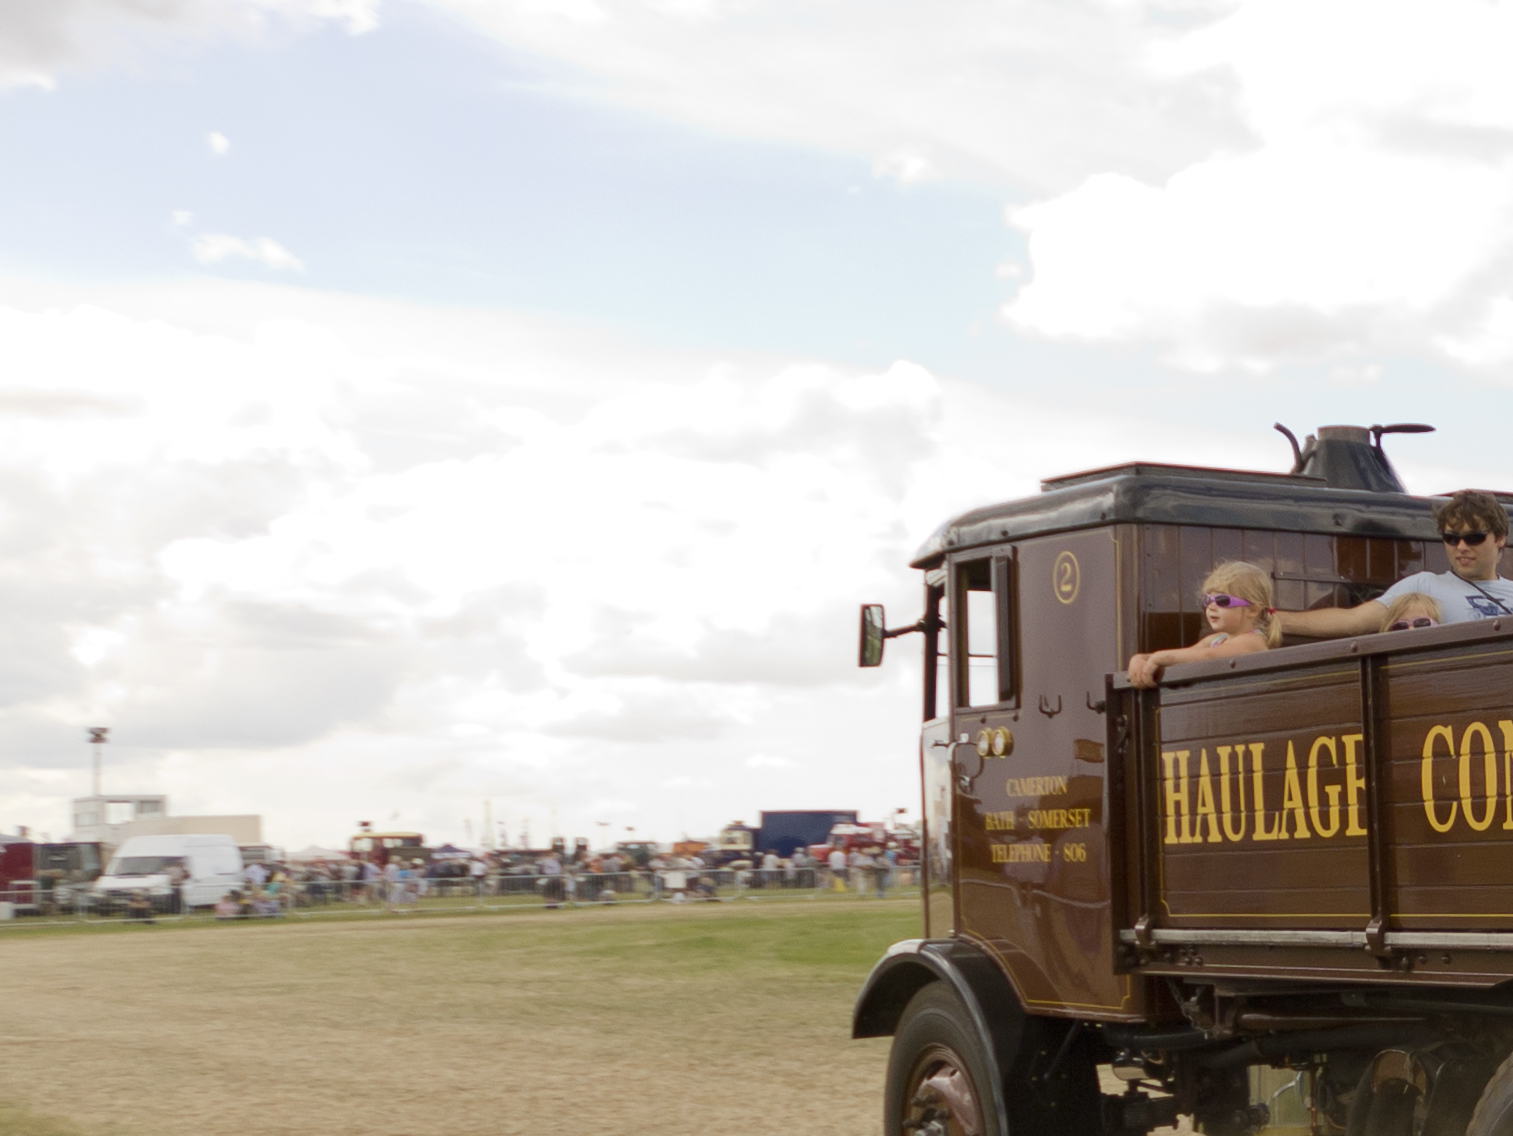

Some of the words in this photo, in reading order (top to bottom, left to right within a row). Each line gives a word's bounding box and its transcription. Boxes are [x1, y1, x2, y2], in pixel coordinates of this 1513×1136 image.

[1061, 562, 1072, 592] 2
[1006, 776, 1068, 797] CAMERTON
[1161, 734, 1368, 845] HAULAGE
[984, 811, 1015, 831] BATH
[1027, 808, 1091, 830] SOMERSET
[990, 843, 1052, 863] TELEPHONE
